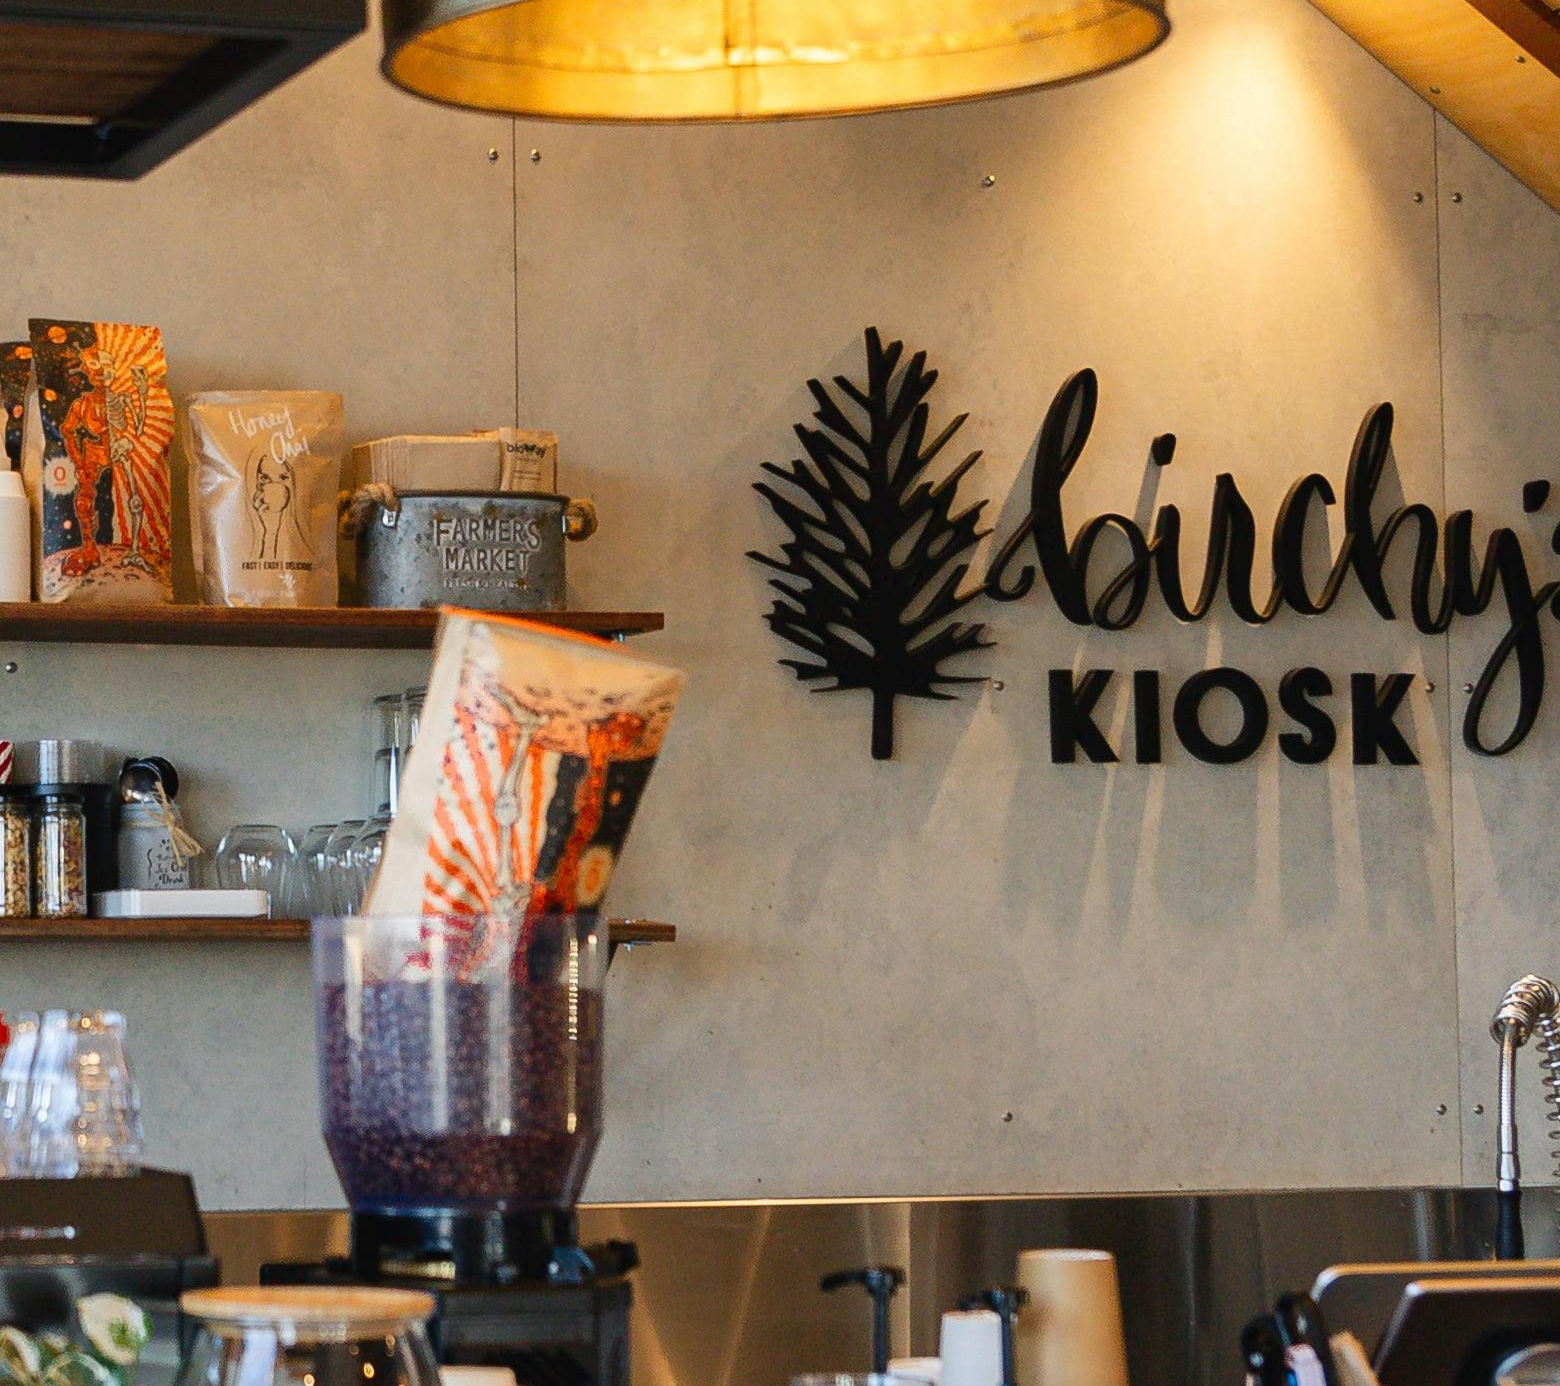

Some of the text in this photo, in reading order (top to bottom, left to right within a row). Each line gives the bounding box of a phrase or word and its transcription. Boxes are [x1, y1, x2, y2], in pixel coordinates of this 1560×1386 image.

[228, 407, 295, 439] Honey
[434, 517, 543, 551] FARMERS
[443, 547, 530, 573] MARKET
[1048, 666, 1422, 766] KIOSK
